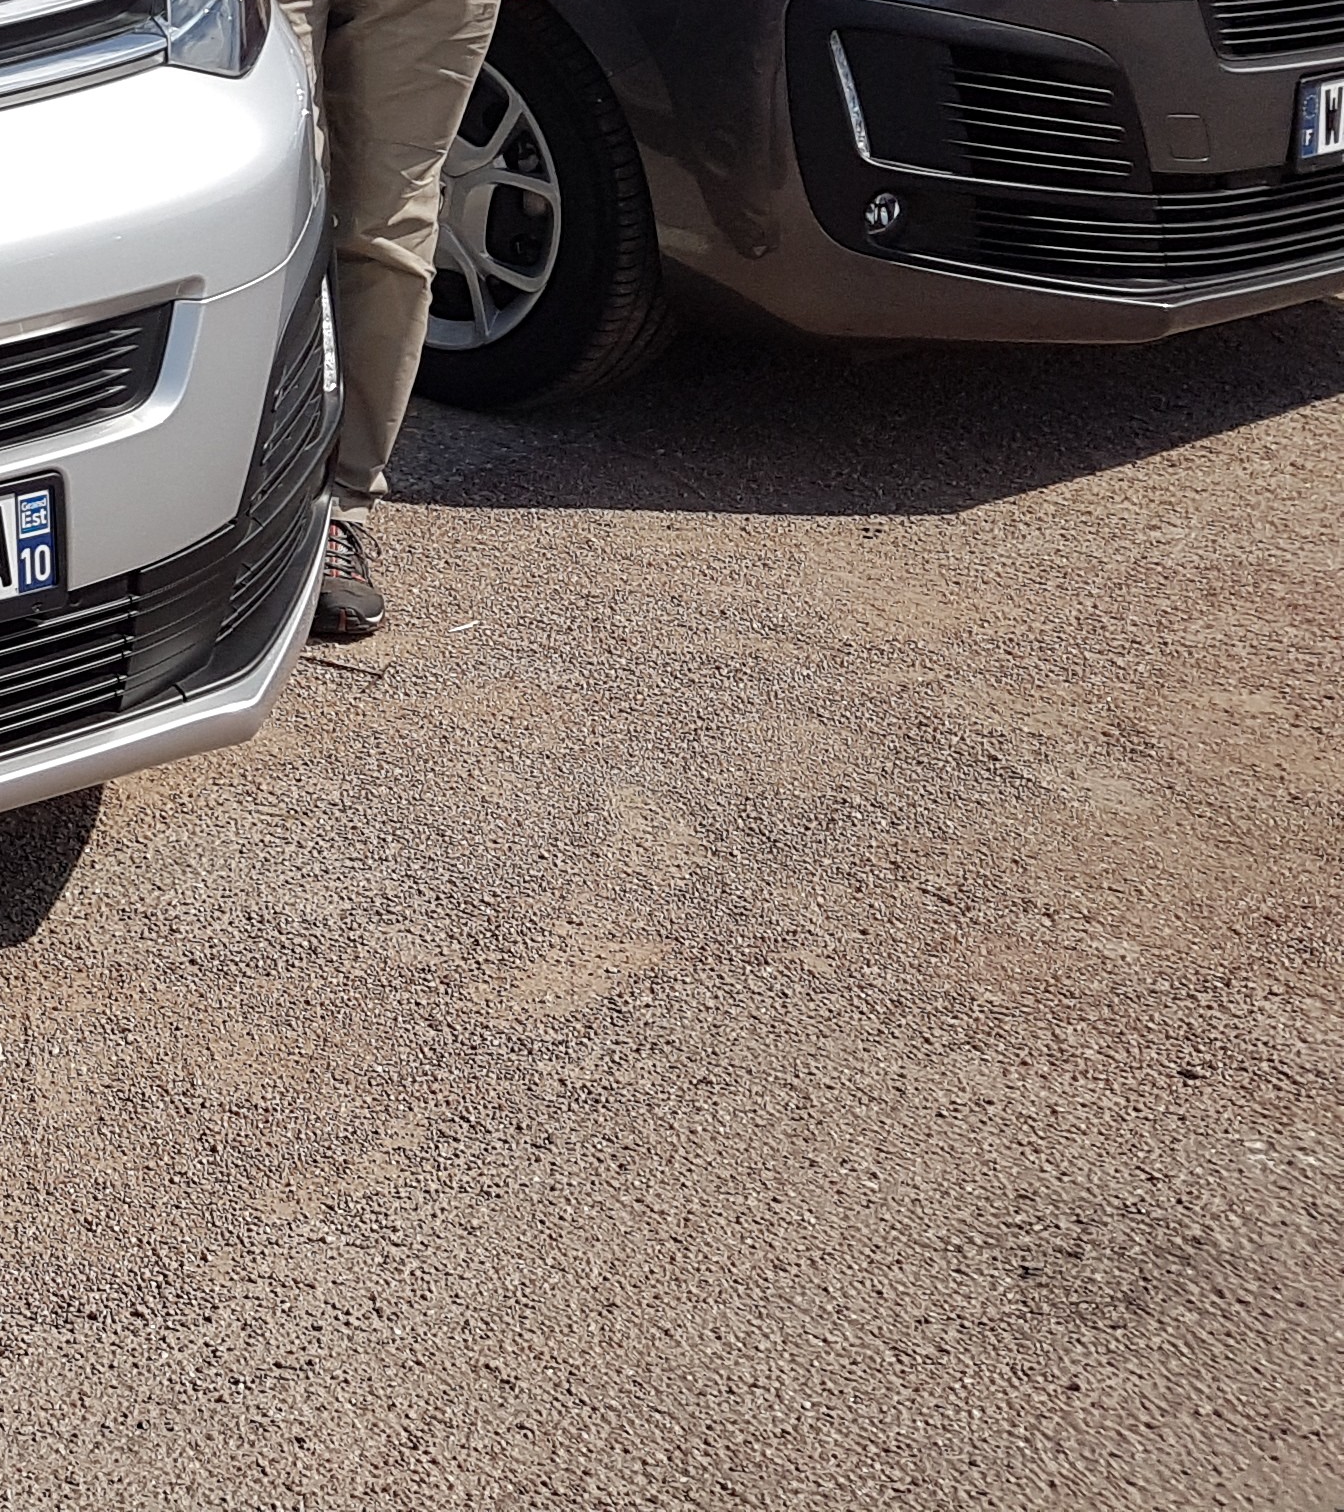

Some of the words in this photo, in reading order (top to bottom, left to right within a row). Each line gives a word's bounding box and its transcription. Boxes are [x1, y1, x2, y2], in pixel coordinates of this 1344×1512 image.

[1305, 129, 1313, 146] F
[21, 508, 47, 529] Est
[20, 544, 51, 585] 10
